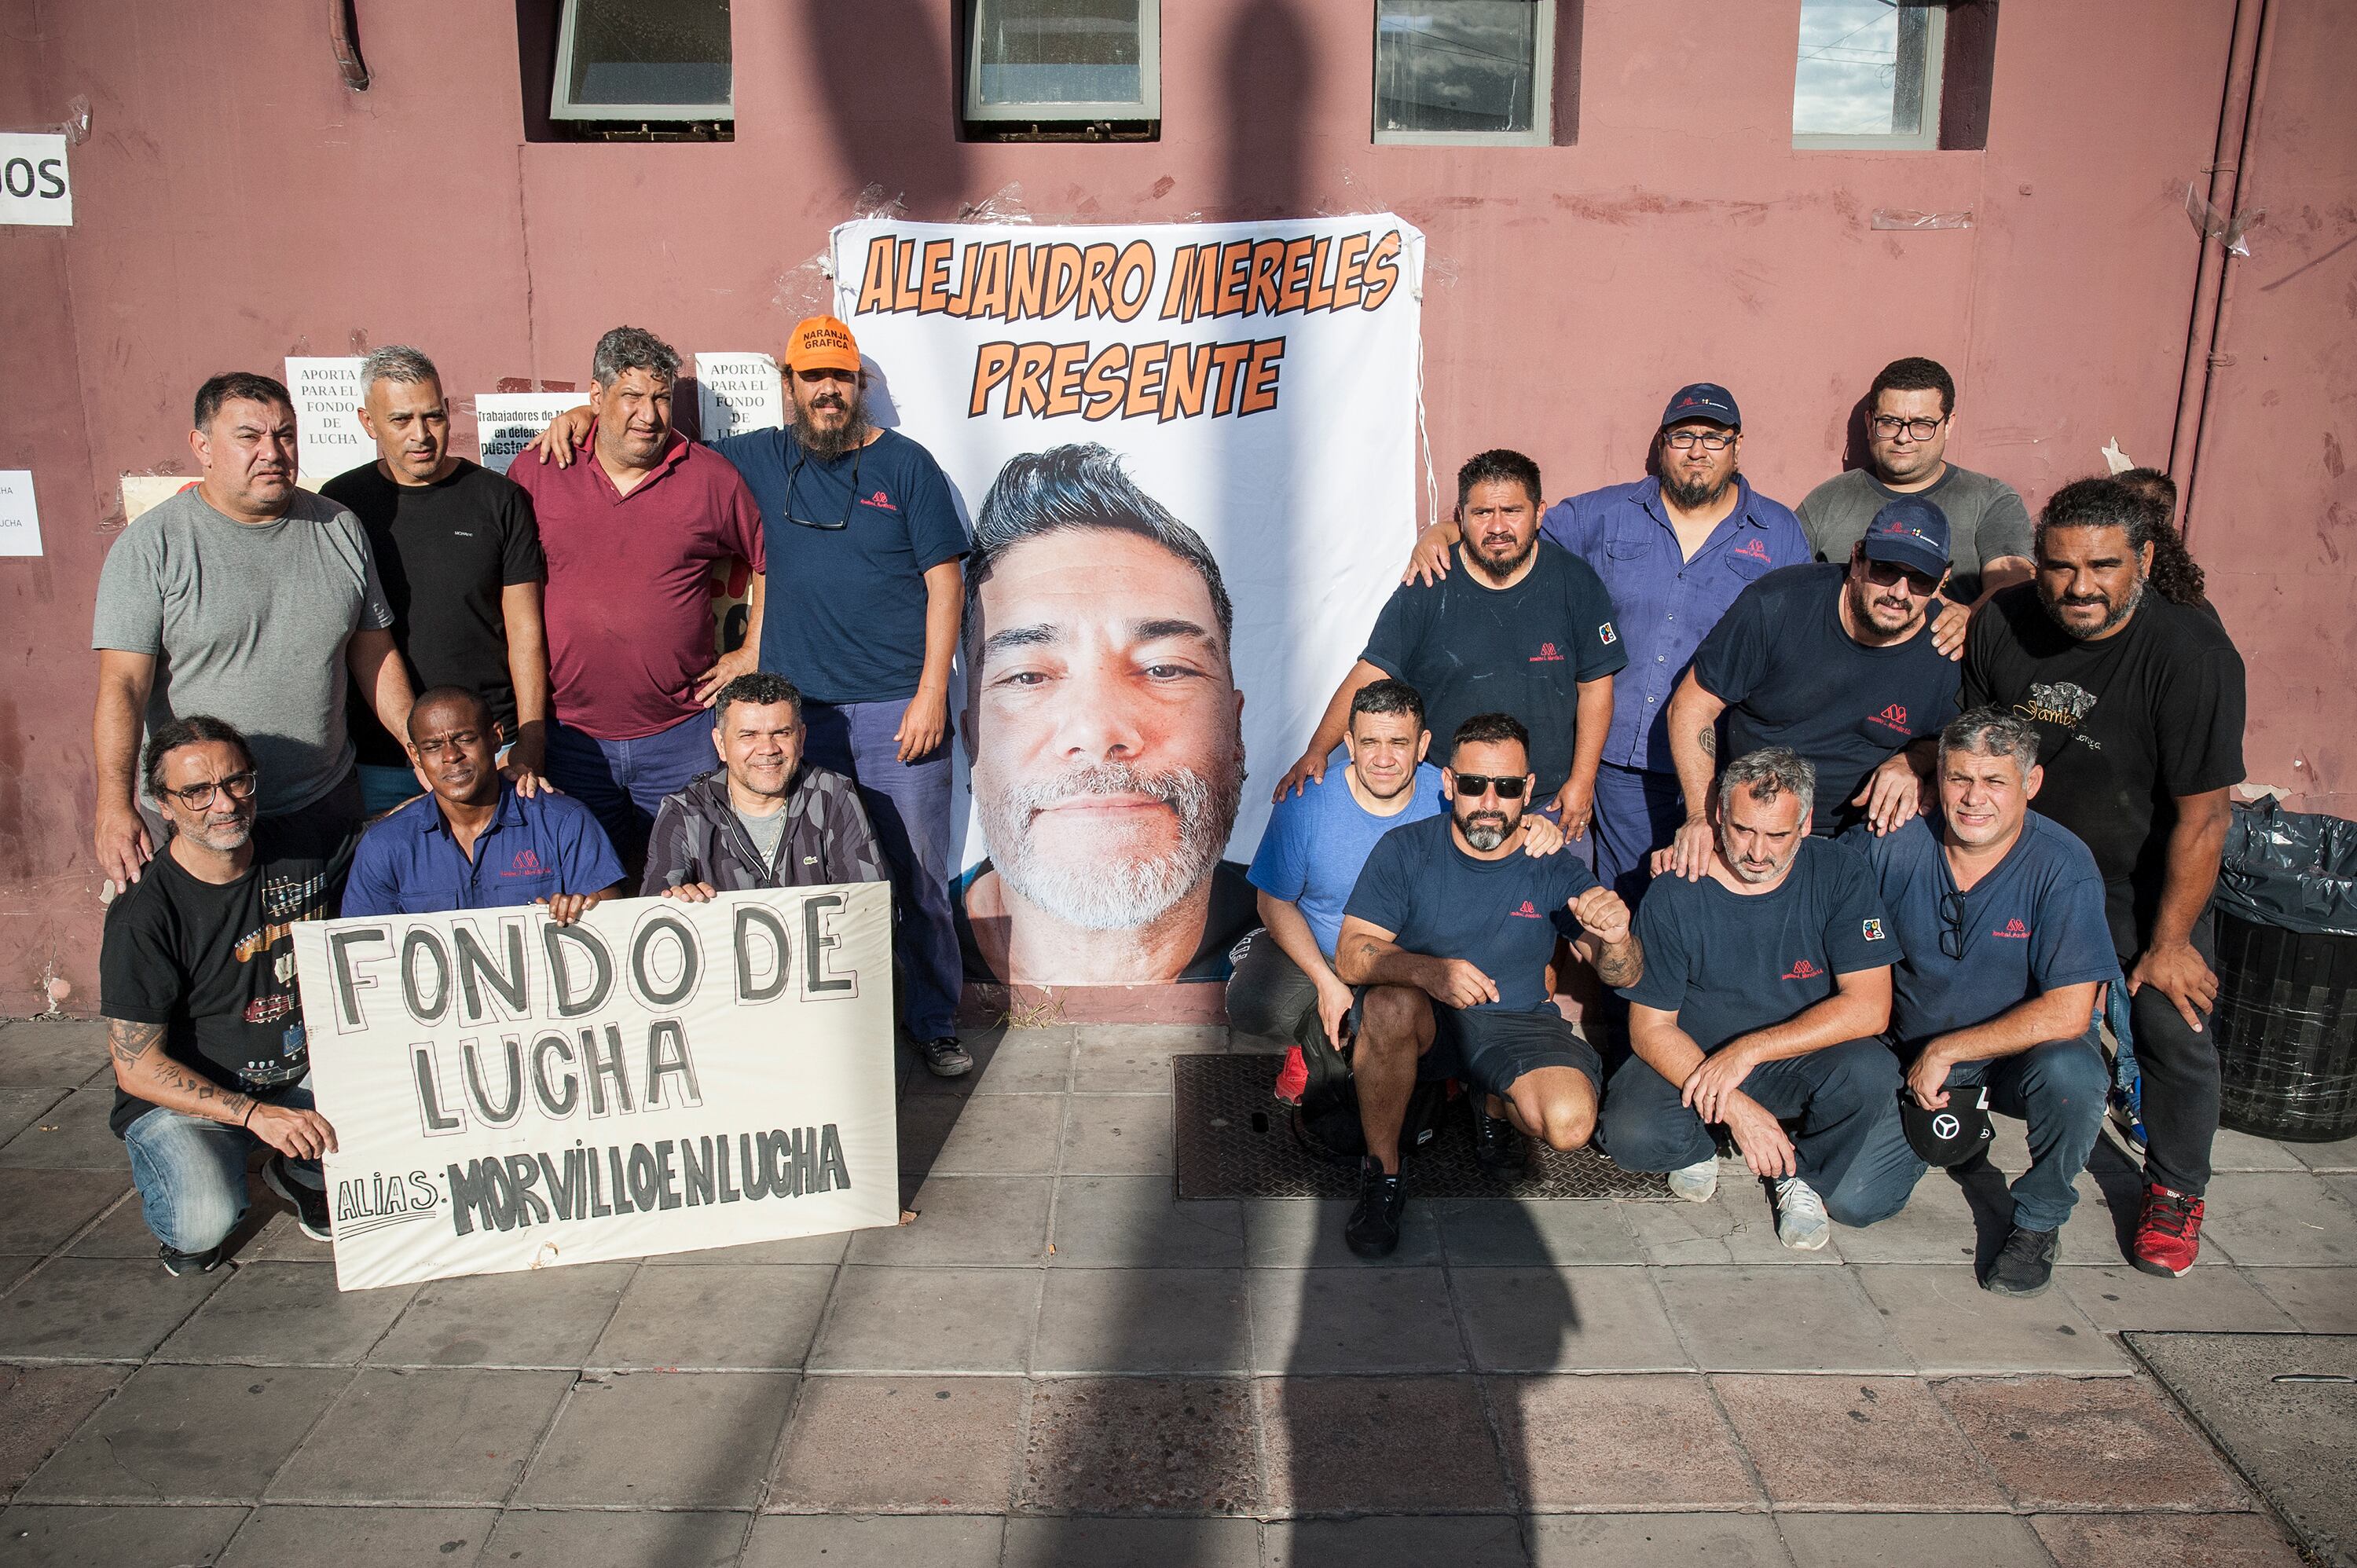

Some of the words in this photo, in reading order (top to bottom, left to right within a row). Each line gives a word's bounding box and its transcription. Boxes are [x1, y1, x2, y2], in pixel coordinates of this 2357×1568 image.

[0, 157, 66, 199] OS
[854, 233, 1157, 324] ALEJANDRO
[1158, 229, 1403, 324] MERELES
[803, 328, 849, 342] NARANJA
[805, 339, 849, 350] GRAFICA
[301, 369, 357, 380] APORTA
[711, 364, 767, 375] APORTA
[968, 335, 1287, 423] PRESENTE
[302, 385, 338, 396] PARA
[341, 386, 359, 397] EL
[712, 380, 748, 391] PARA
[751, 381, 769, 391] EL
[307, 401, 355, 412] FONDO
[716, 396, 765, 408] FONDO
[323, 417, 342, 428] DE
[478, 410, 539, 423] Trabajadores
[542, 410, 553, 421] de
[731, 412, 751, 423] DE
[494, 428, 507, 438] en
[508, 427, 546, 438] defens
[310, 433, 358, 445] LUCHA
[324, 905, 706, 1035] FONDO
[732, 891, 859, 1006] DE
[409, 1016, 703, 1138] LUCHA
